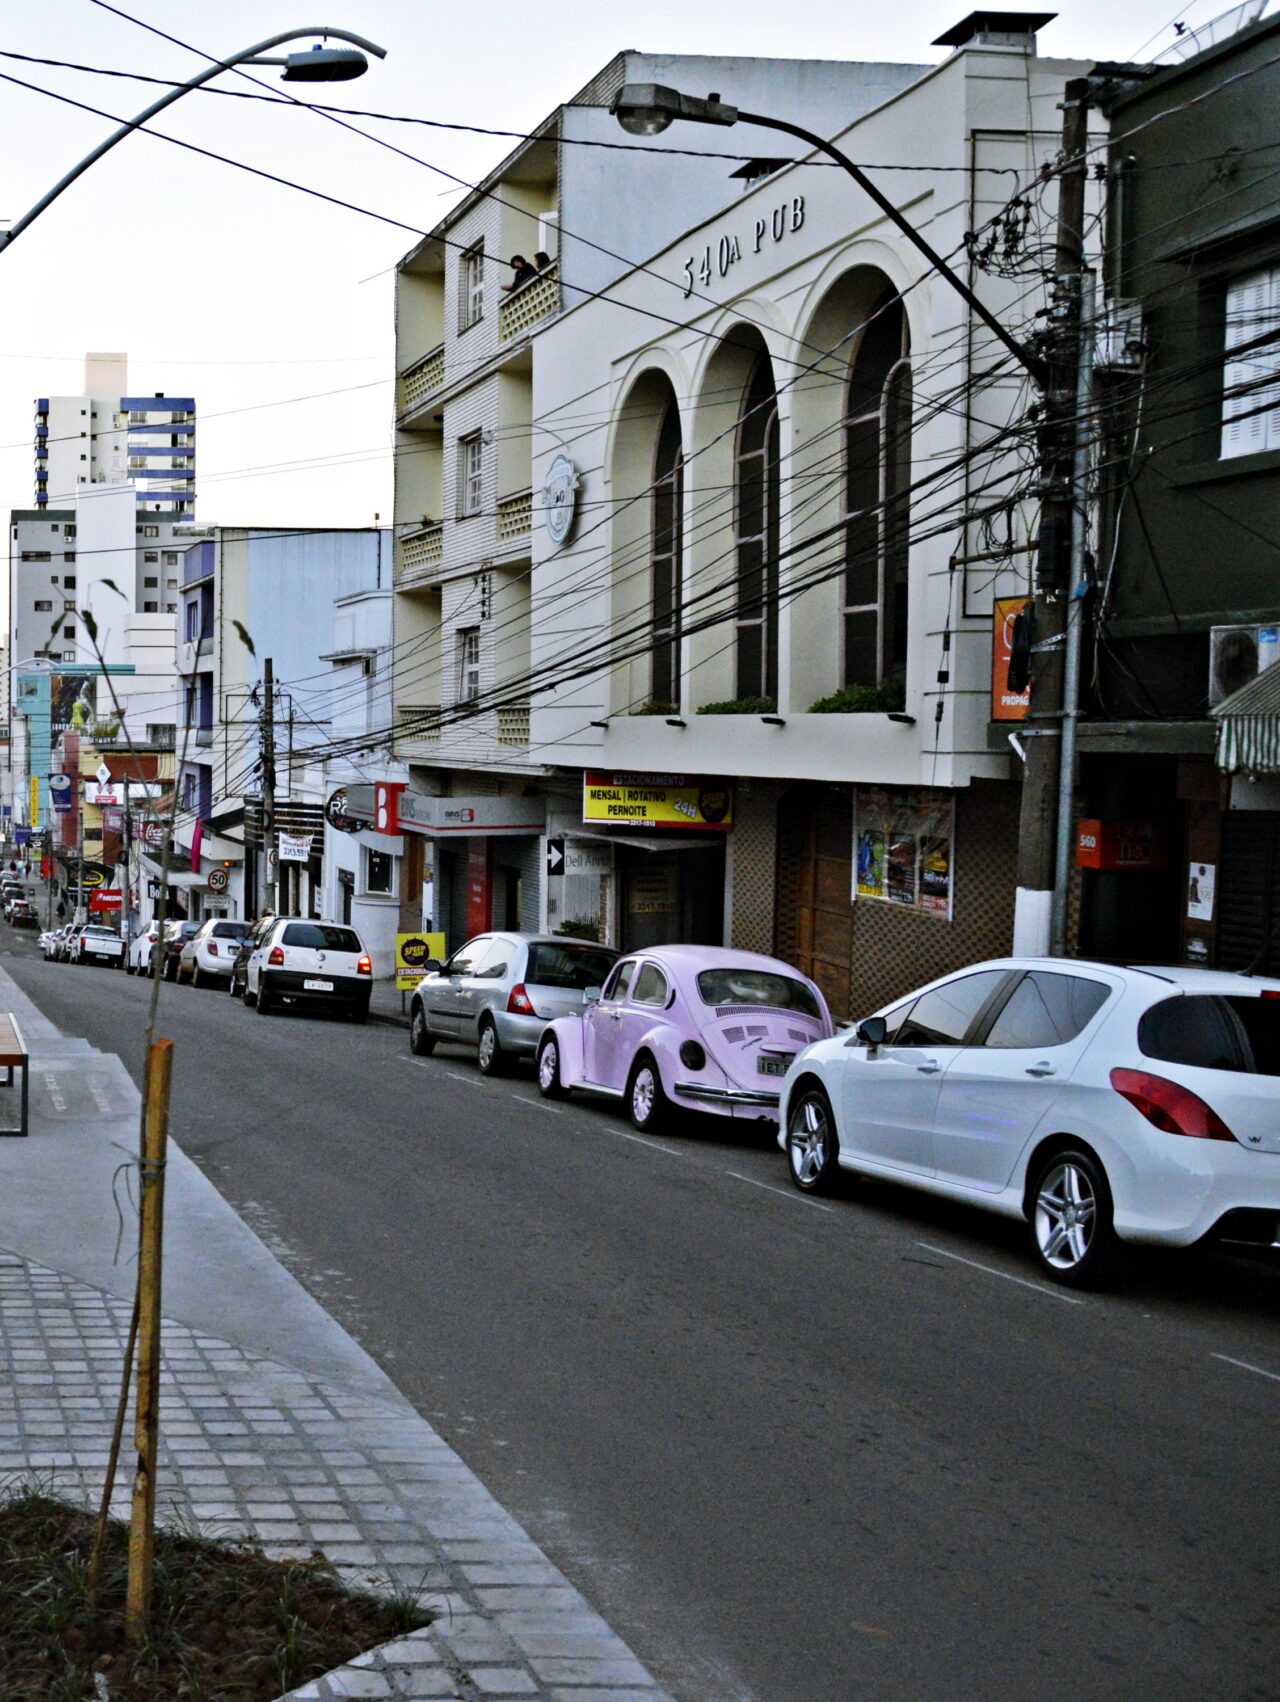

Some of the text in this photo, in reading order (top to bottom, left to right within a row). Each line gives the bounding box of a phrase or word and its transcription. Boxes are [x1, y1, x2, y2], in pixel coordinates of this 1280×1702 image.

[752, 195, 805, 254] PUB
[613, 774, 685, 786] ESTACIONAMENTO
[590, 789, 666, 802] MENSAL ROTATIVO
[607, 805, 647, 816] PERNOITE
[673, 798, 697, 818] 24H
[1080, 835, 1096, 848] 560
[211, 877, 225, 886] 50
